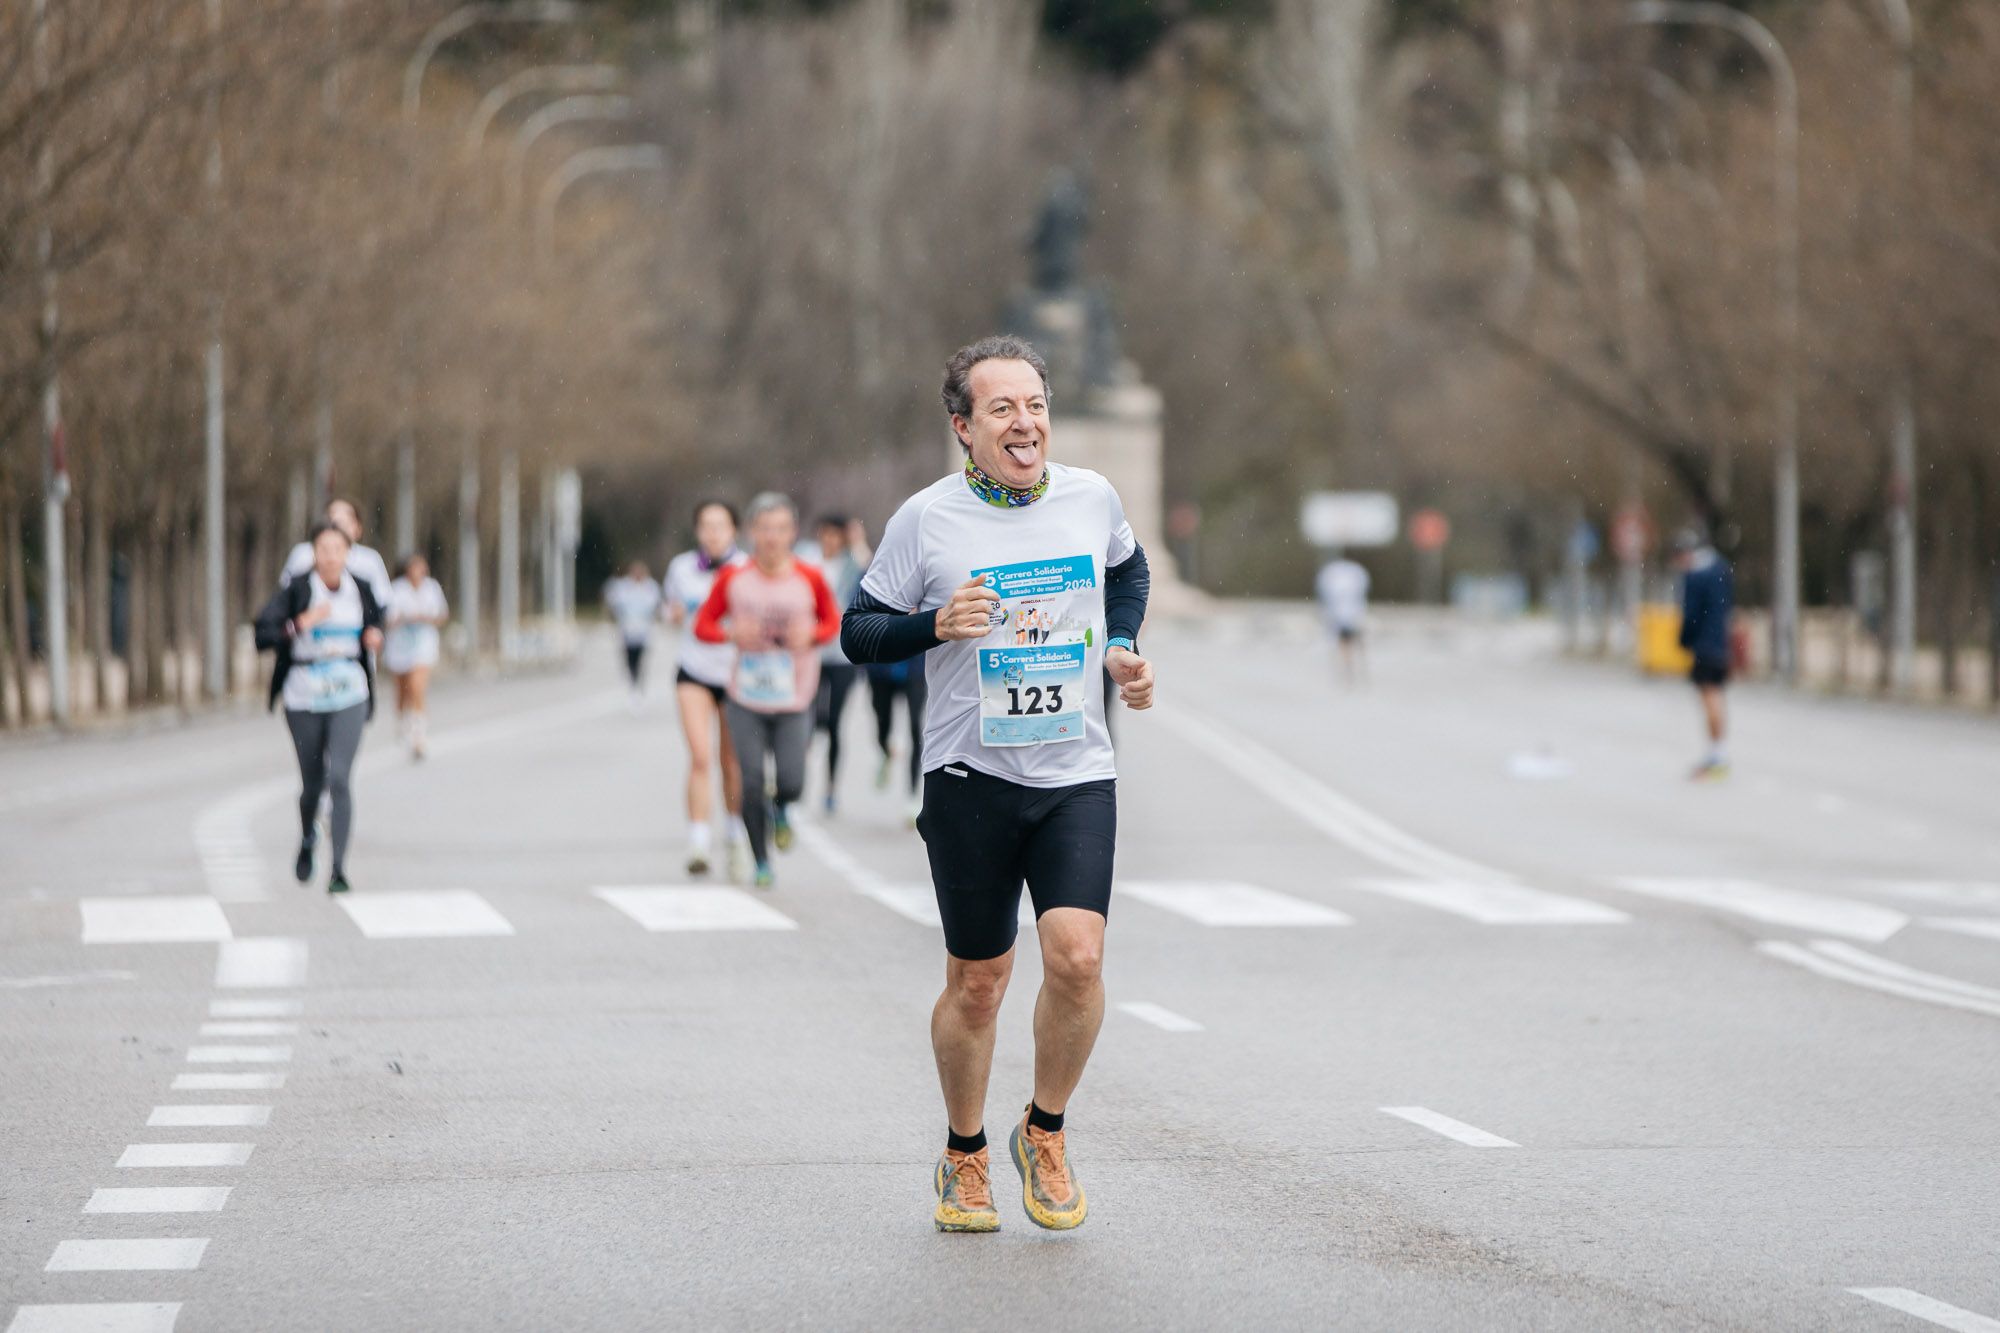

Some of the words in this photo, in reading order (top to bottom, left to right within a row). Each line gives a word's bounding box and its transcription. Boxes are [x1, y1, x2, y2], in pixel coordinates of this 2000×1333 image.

[998, 571, 1032, 580] Carrera
[1034, 565, 1072, 575] Solidaria
[1064, 578, 1093, 592] 2026
[1002, 655, 1034, 664] Carrera
[1036, 652, 1071, 662] Solidaria
[1008, 685, 1063, 715] 123
